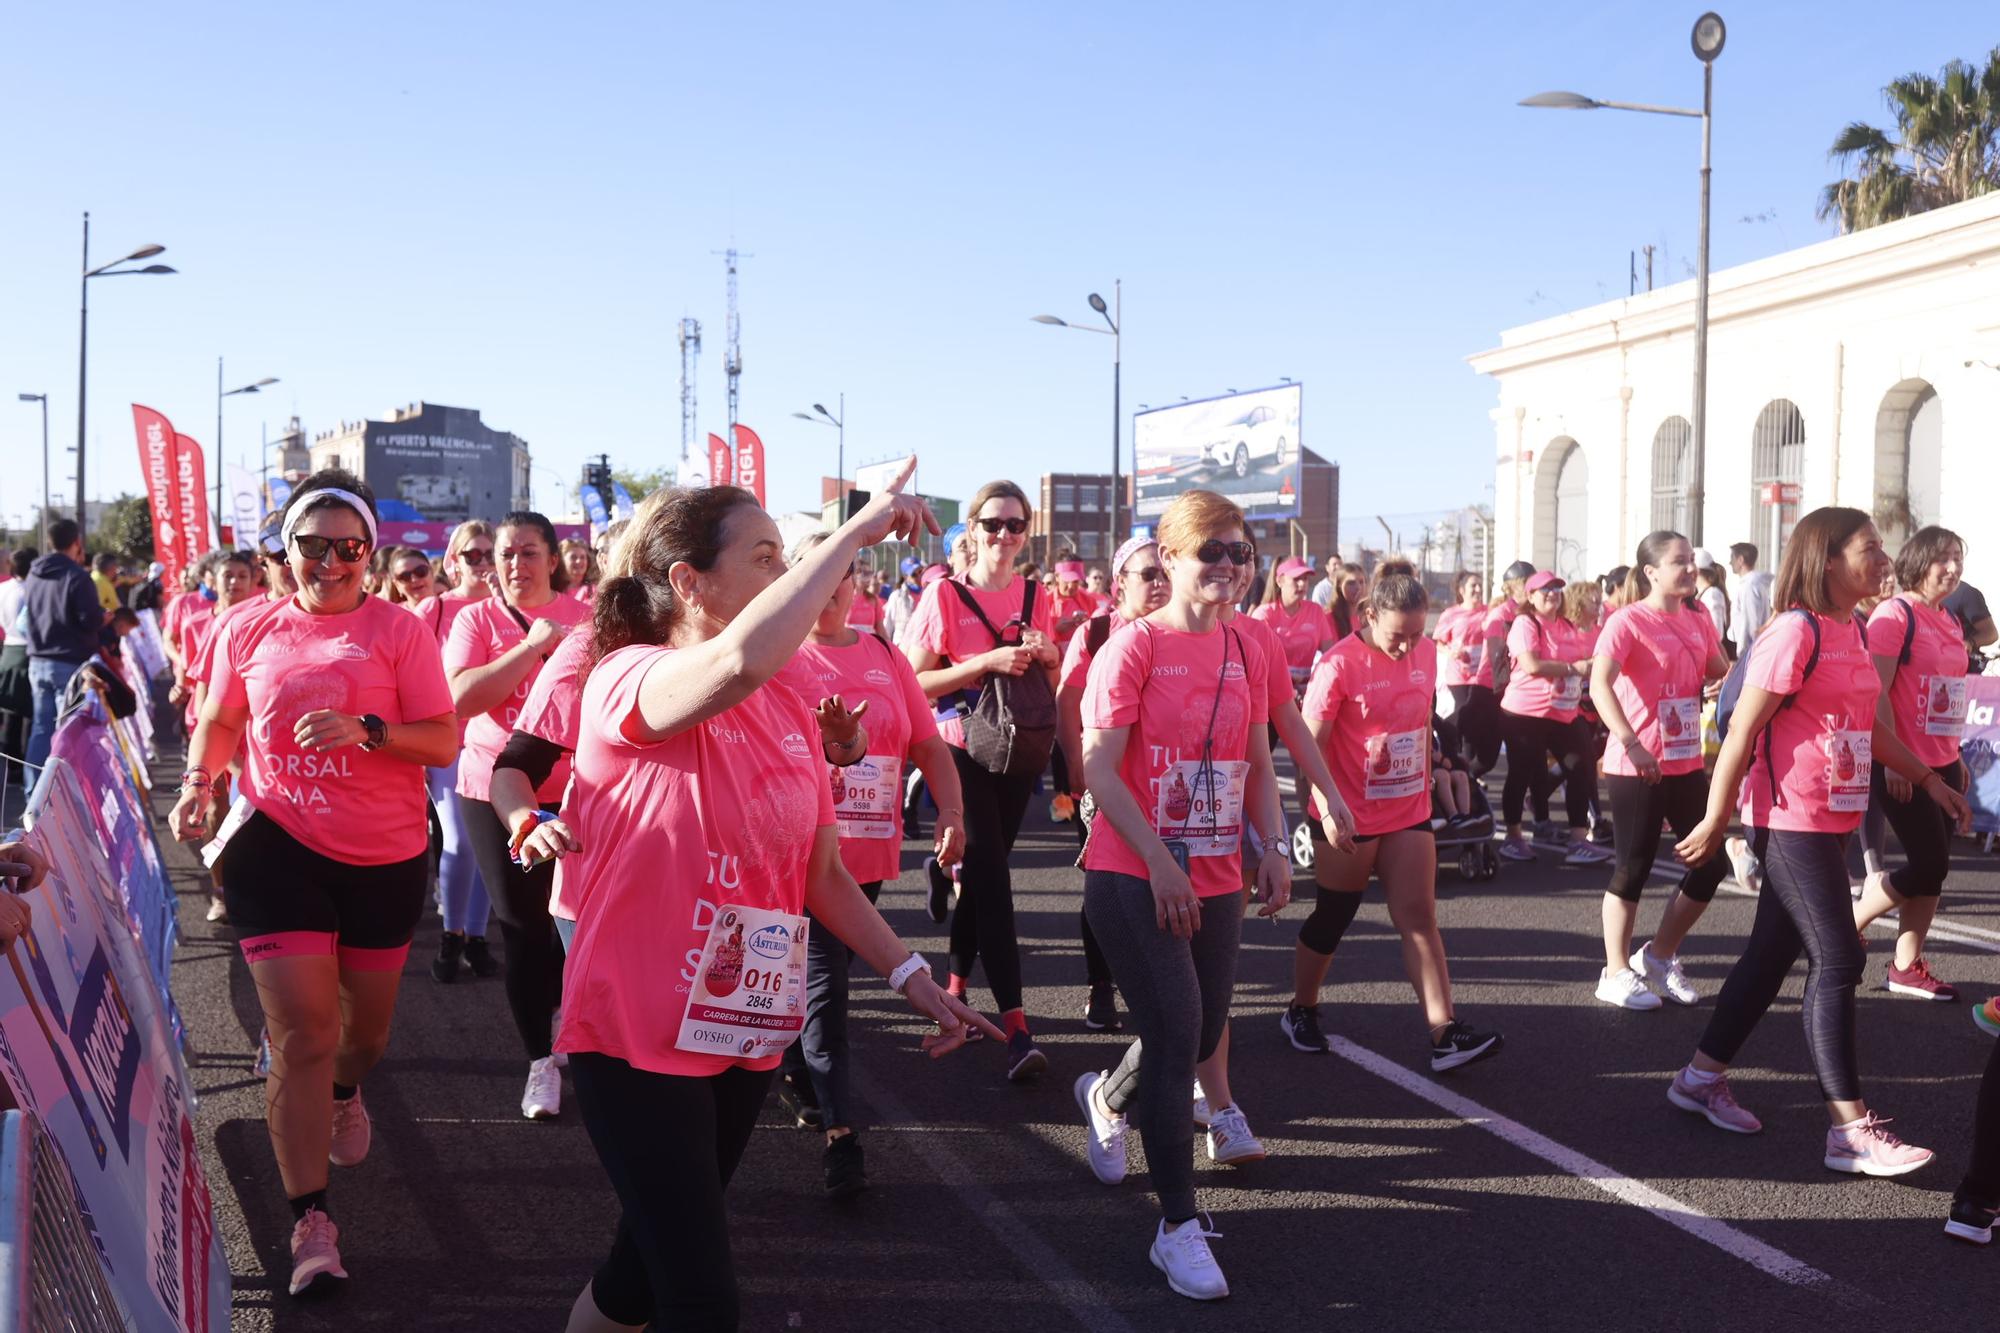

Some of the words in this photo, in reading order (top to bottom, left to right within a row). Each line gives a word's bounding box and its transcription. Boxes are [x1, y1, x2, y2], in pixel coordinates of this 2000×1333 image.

[388, 434, 427, 448] PUERTO
[1965, 699, 1994, 726] la
[1393, 757, 1412, 769] 016
[1857, 762, 1870, 774] 016
[849, 787, 876, 800] 016
[853, 801, 871, 810] 5598
[743, 968, 782, 993] 016
[746, 994, 773, 1010] 2845
[703, 1010, 739, 1022] CARRERA
[740, 1015, 750, 1024] DE
[751, 1017, 761, 1025] LA
[761, 1018, 784, 1028] MUJER
[693, 1029, 734, 1045] OYSHO
